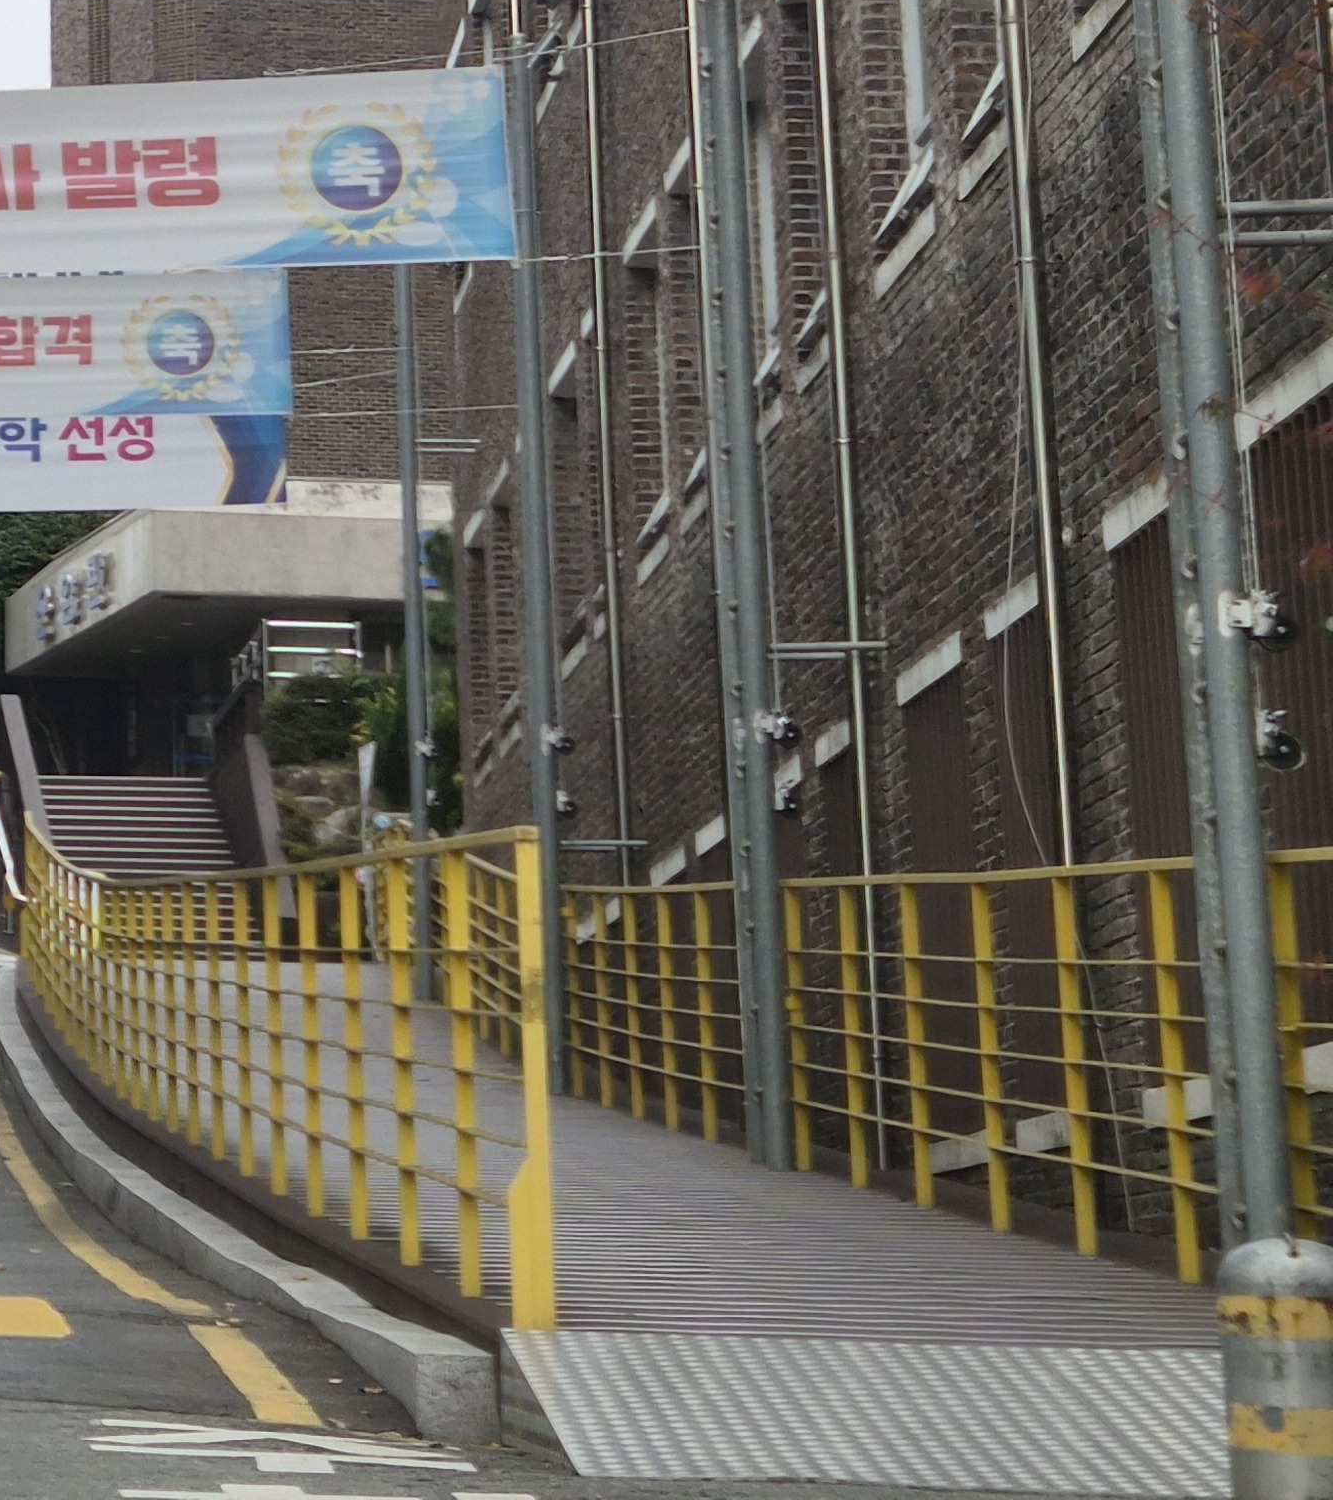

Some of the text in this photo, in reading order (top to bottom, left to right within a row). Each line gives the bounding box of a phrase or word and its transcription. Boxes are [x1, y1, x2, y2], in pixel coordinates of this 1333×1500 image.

[61, 136, 220, 209] 발령
[327, 142, 386, 199] 축
[158, 325, 202, 365] 축
